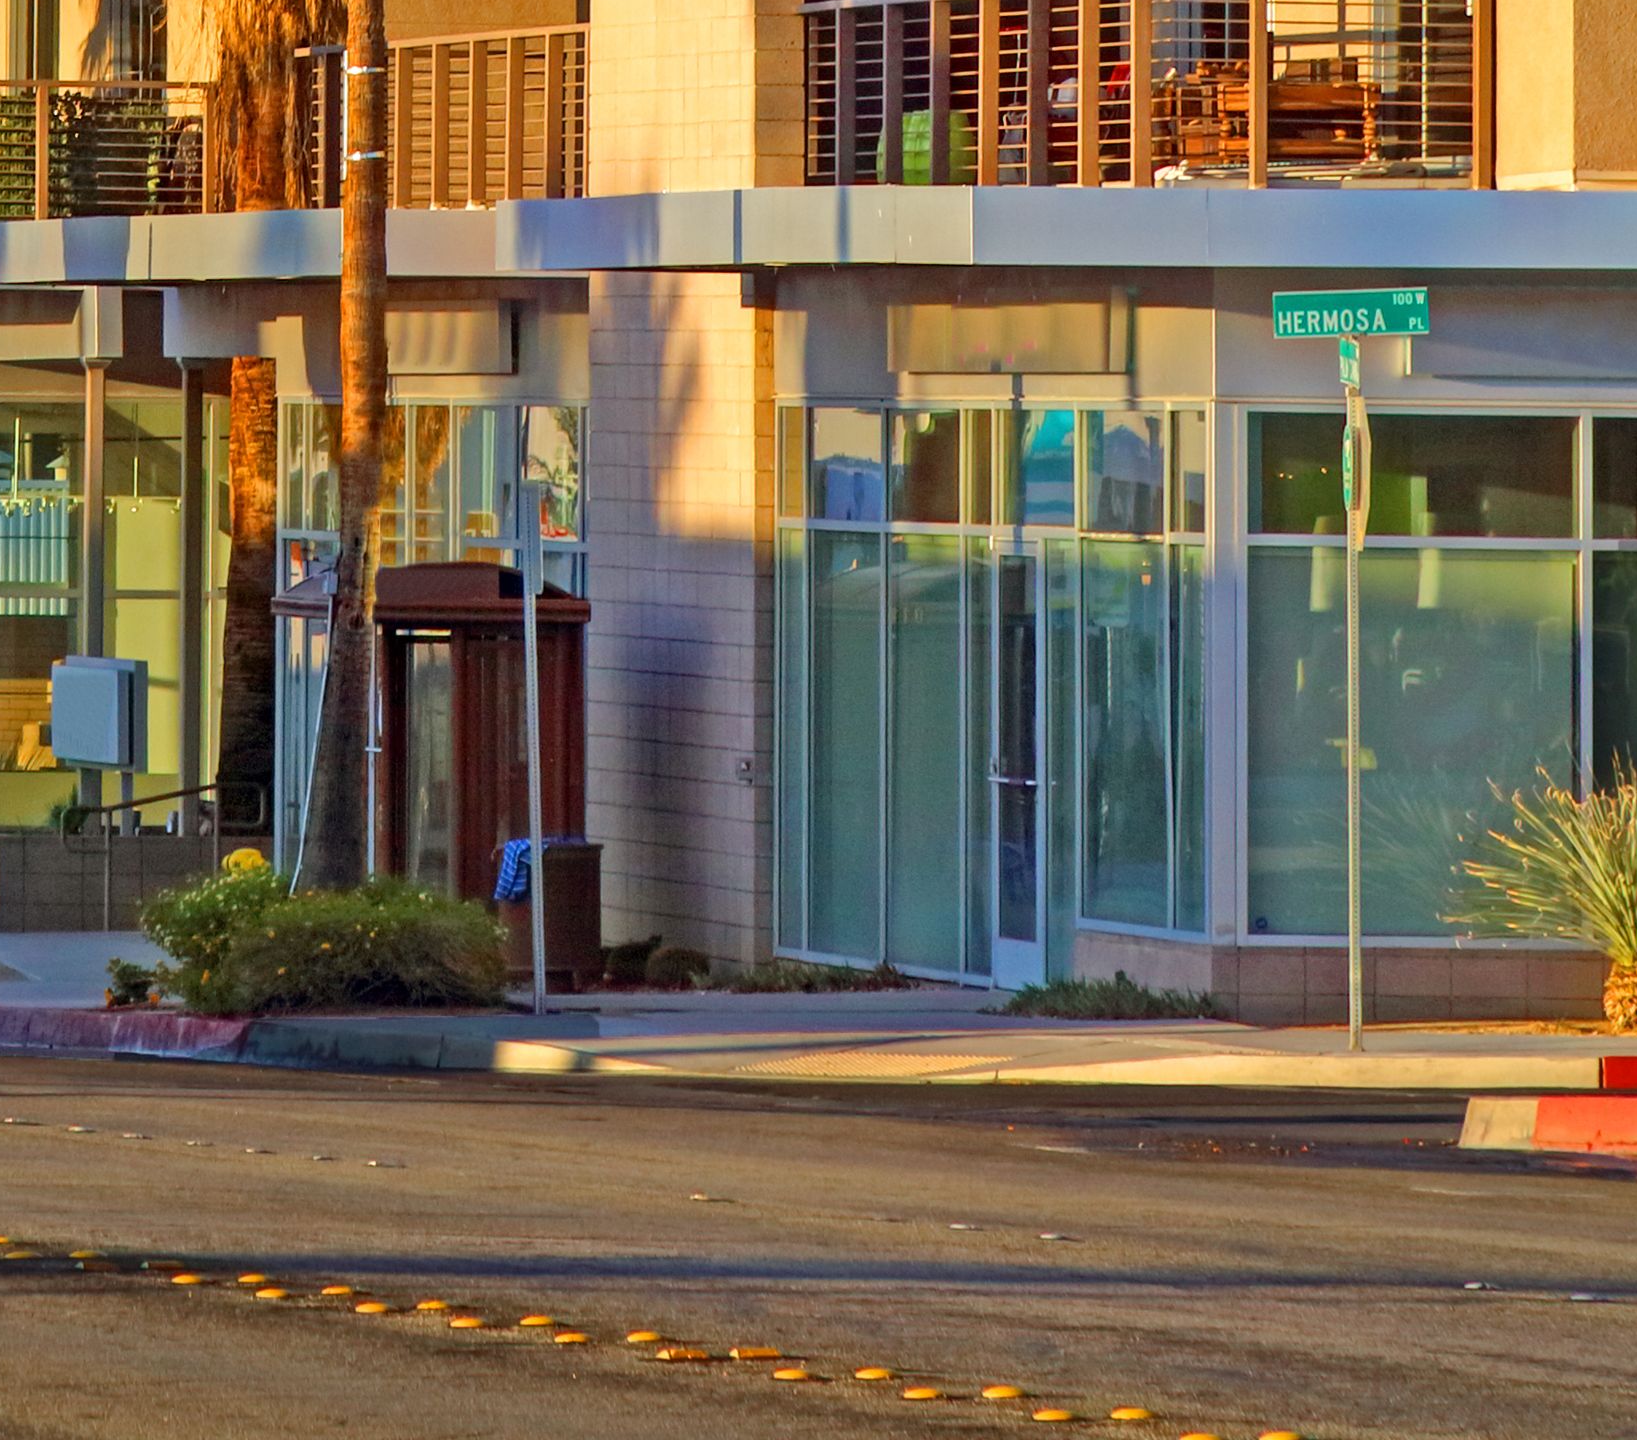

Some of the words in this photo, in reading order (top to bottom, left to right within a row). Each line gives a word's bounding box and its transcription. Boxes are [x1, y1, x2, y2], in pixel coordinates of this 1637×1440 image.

[1392, 293, 1413, 305] 100
[1415, 292, 1425, 305] W
[1278, 308, 1387, 334] HERMOSA
[1408, 317, 1424, 330] PL
